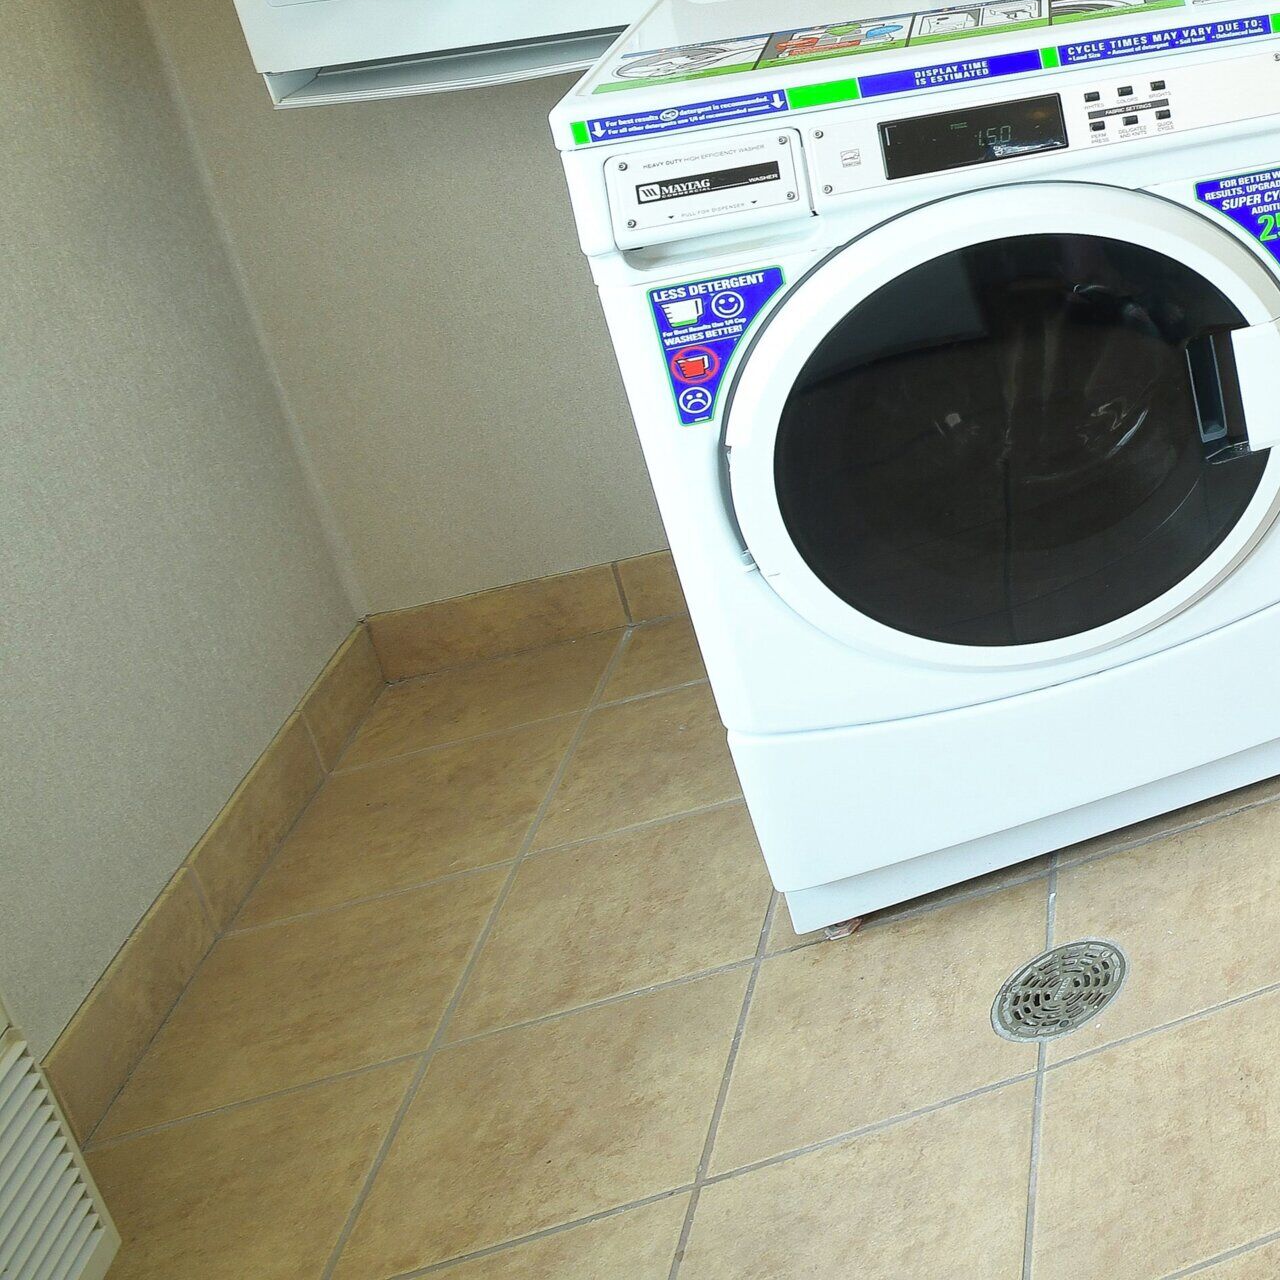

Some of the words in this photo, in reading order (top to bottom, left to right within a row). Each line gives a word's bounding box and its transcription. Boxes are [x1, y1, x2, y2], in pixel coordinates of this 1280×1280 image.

[1067, 43, 1105, 55] CYCLE
[1110, 36, 1147, 49] TIMES
[1152, 32, 1177, 42] MAY
[1183, 26, 1212, 38] VARY
[1217, 21, 1239, 33] DUE
[1243, 19, 1262, 28] TO:
[1112, 47, 1134, 55] Amount
[1142, 42, 1169, 50] detergent
[914, 66, 958, 78] DISPLAY
[962, 61, 988, 70] TIME
[916, 78, 926, 86] IS
[931, 68, 989, 83] ESTIMATED
[618, 118, 634, 126] best
[680, 106, 712, 115] detergent
[643, 161, 664, 169] HEAVY
[666, 158, 682, 166] DUTY
[701, 149, 737, 160] EFFICIENCY
[738, 144, 765, 153] WASHER
[661, 179, 710, 195] MAYTAG
[748, 173, 778, 183] WASHER
[1220, 178, 1237, 189] FOR
[1238, 172, 1272, 185] BETTER
[1205, 187, 1246, 201] RESULTS,
[1222, 193, 1262, 211] SUPER
[653, 287, 686, 302] LESS
[688, 272, 765, 296] DETERGENT
[662, 329, 673, 338] For
[712, 320, 724, 329] Use
[734, 317, 747, 326] Cup
[664, 332, 704, 347] WASHES
[705, 324, 743, 338] BETTER!
